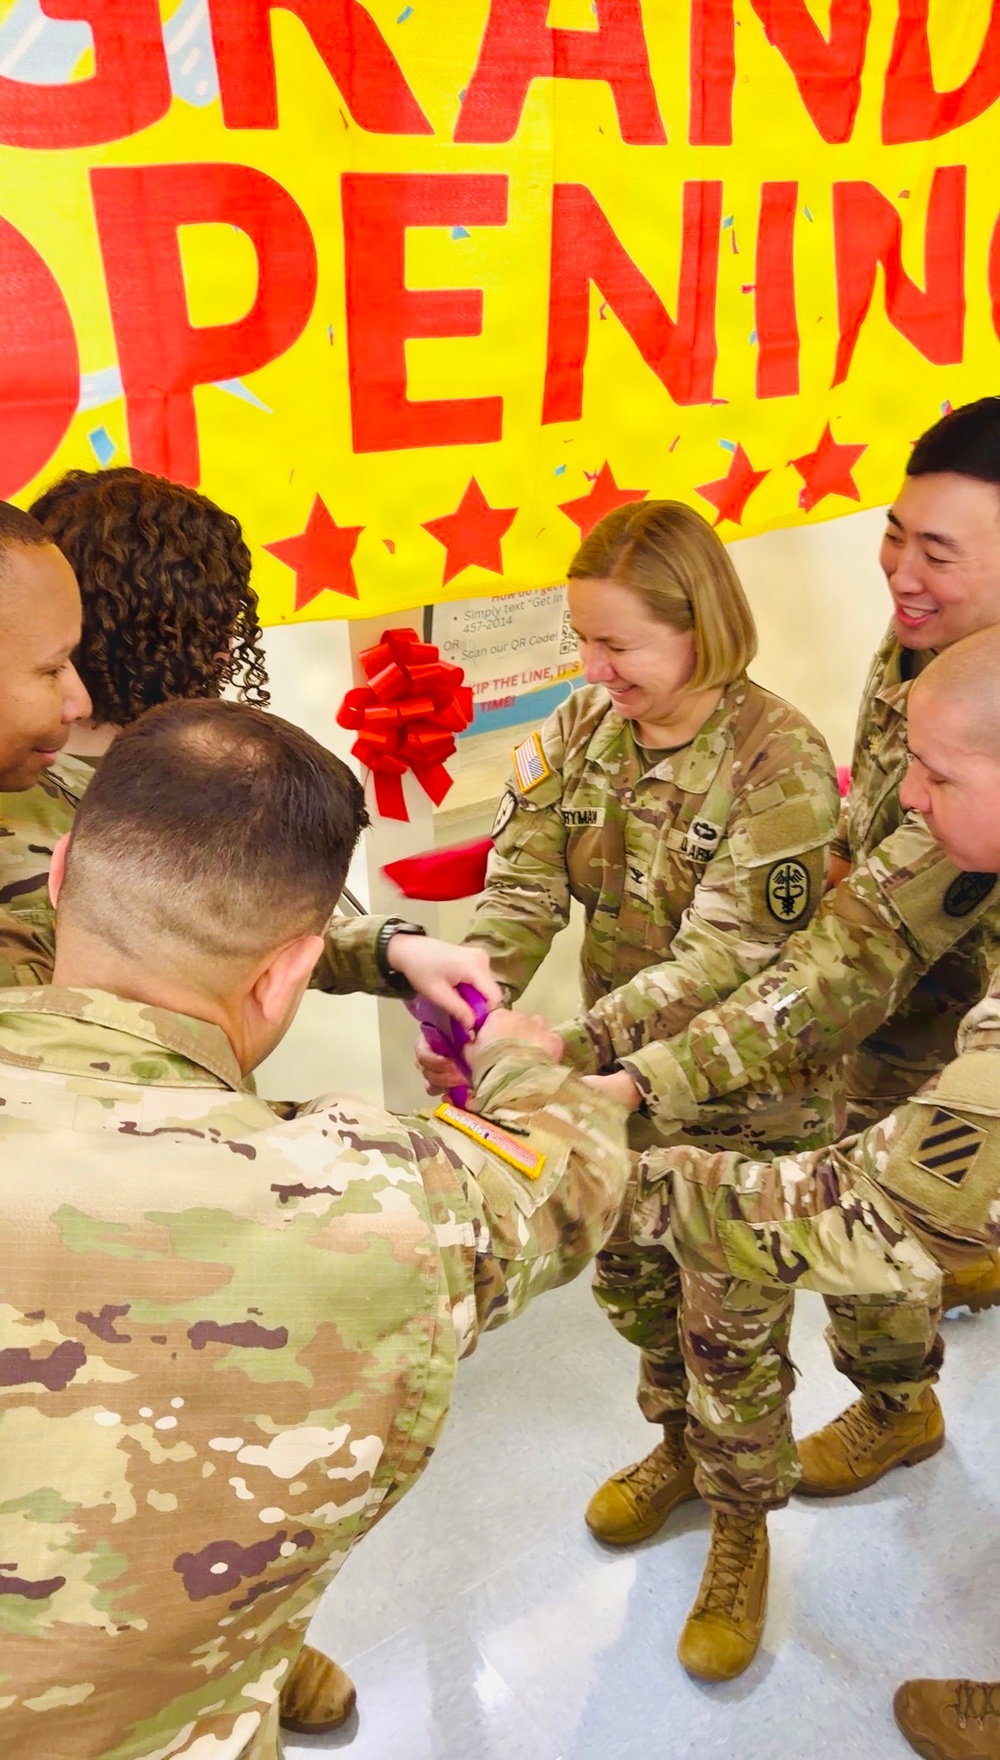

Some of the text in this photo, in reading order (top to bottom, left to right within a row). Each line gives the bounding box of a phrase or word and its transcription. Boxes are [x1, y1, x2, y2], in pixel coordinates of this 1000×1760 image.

[0, 163, 1000, 502] PENIN
[464, 605, 501, 622] Simply
[504, 601, 525, 614] text
[463, 616, 513, 634] 457-2014
[443, 639, 460, 651] OR
[462, 631, 559, 661] Scan our QR Code!
[493, 675, 519, 691] THE
[521, 667, 554, 684] LINE,
[479, 695, 516, 714] TIME!
